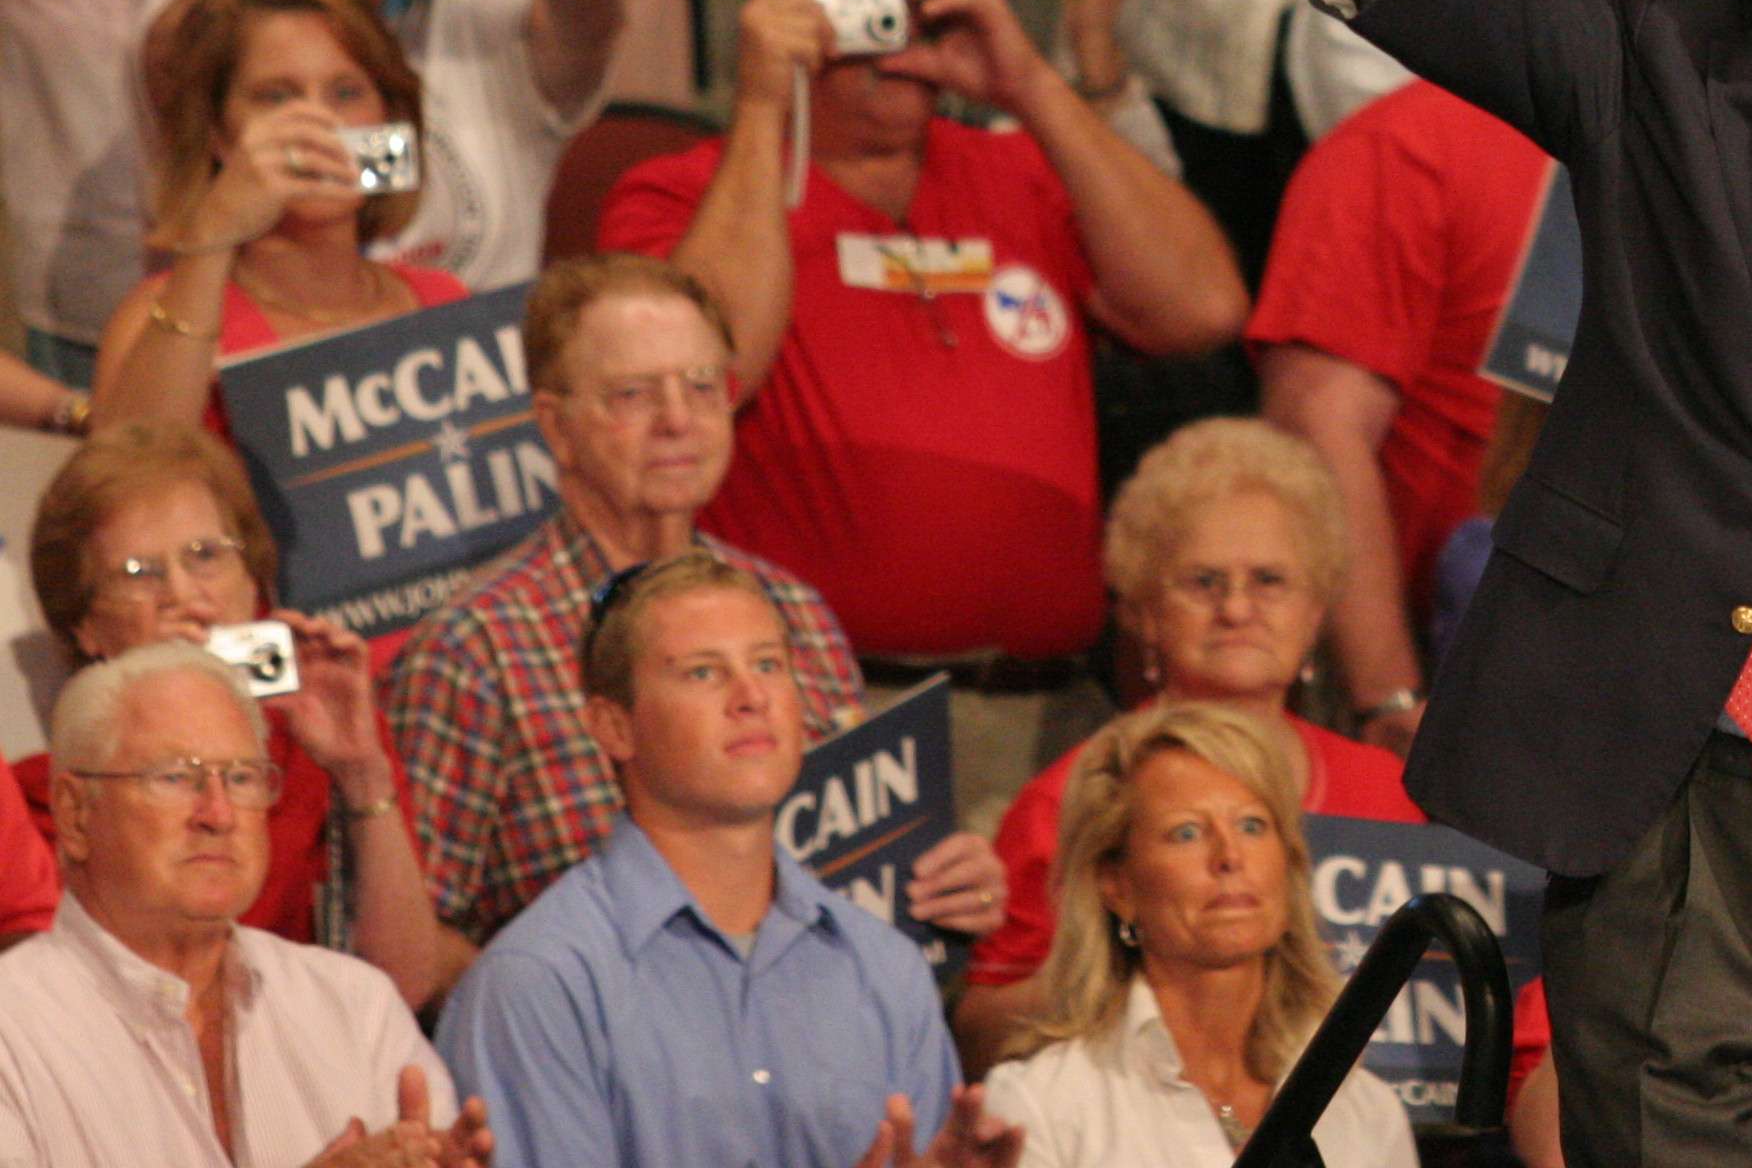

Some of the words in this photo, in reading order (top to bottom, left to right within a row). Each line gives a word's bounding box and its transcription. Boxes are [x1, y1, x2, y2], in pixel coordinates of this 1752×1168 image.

[285, 325, 531, 458] McCAI
[775, 735, 920, 863] CAIN
[1310, 854, 1508, 938] CAN
